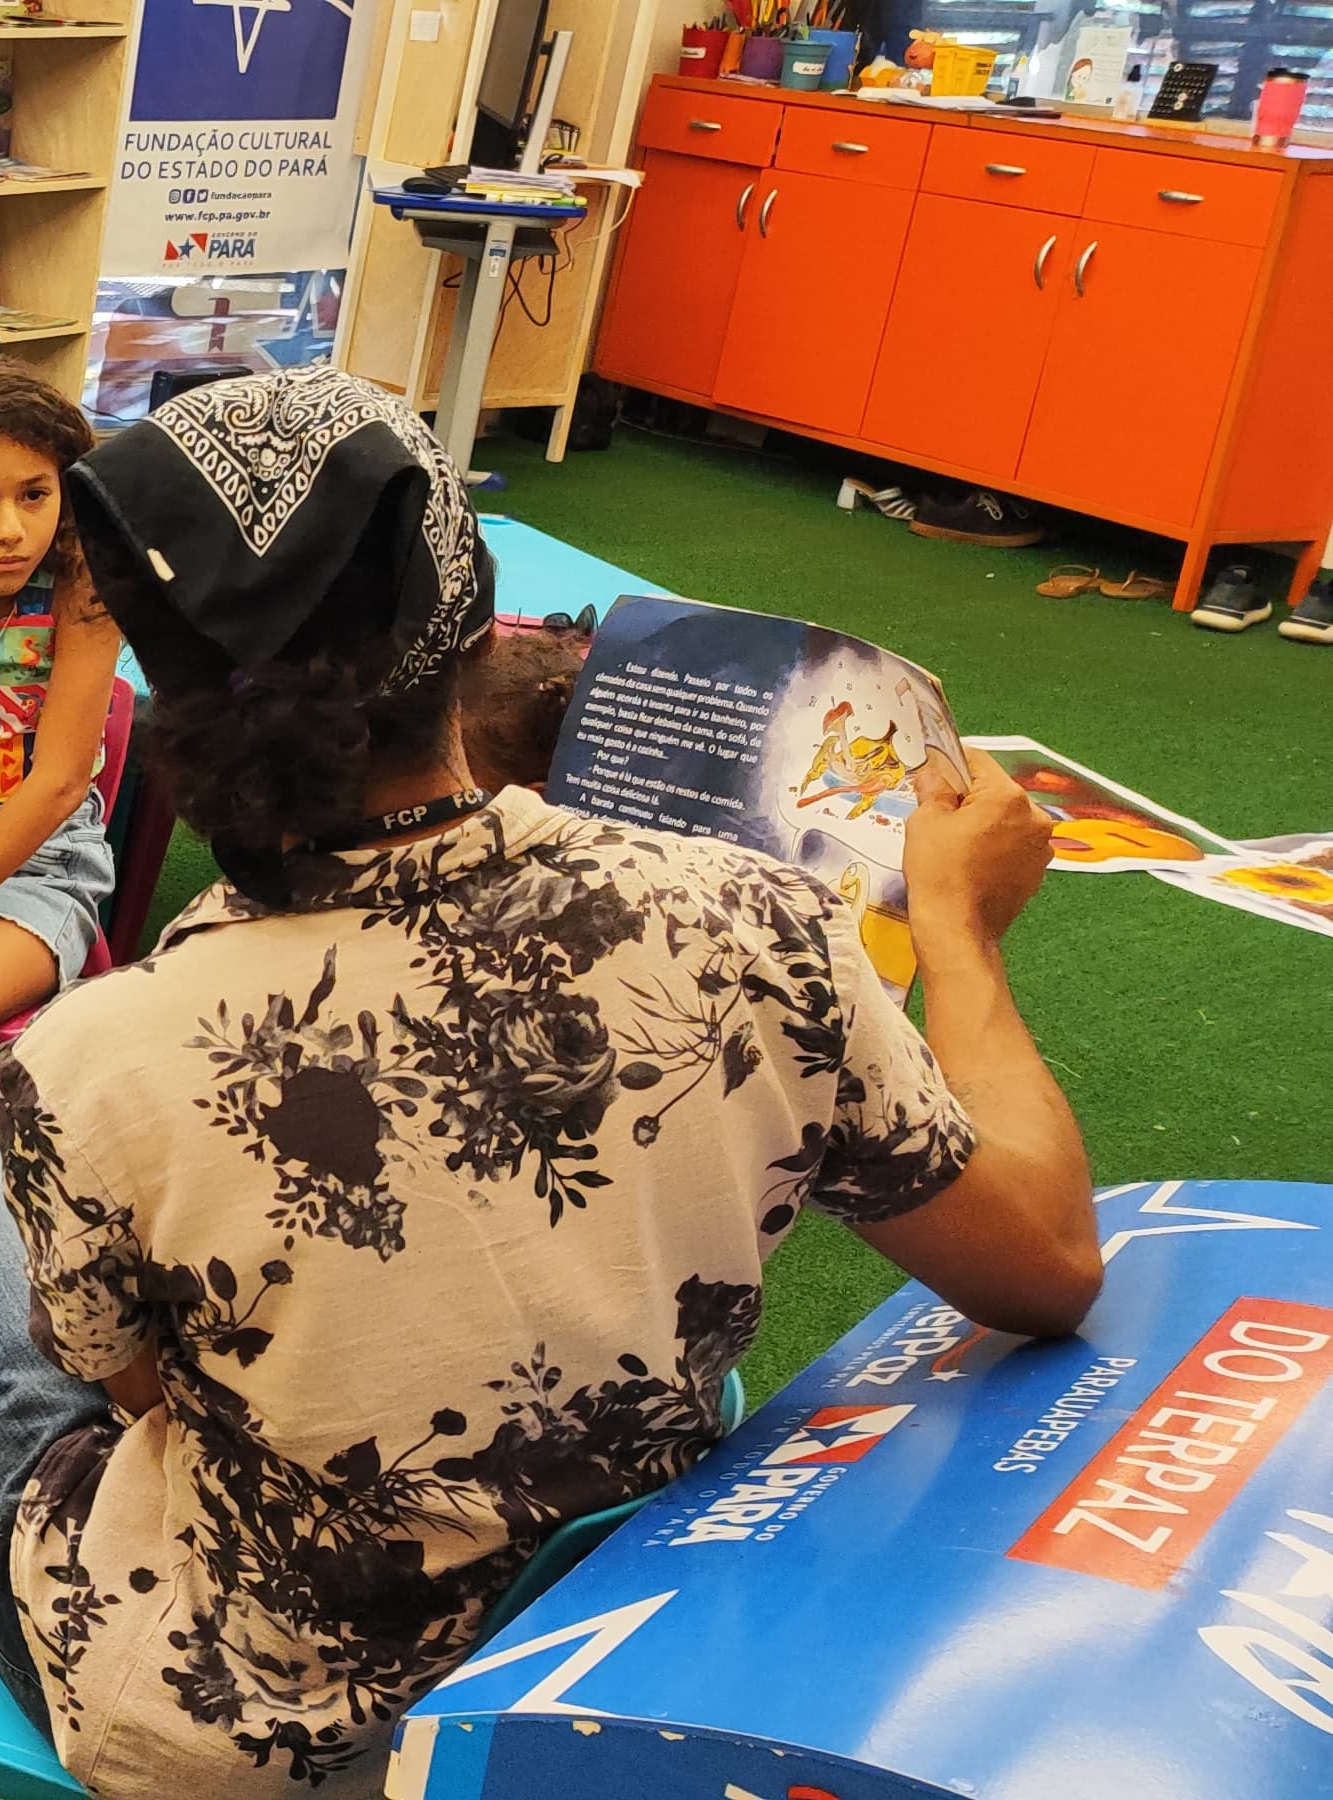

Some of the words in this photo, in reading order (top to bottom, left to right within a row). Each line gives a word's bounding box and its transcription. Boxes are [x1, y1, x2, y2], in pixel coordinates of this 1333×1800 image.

[124, 130, 234, 157] FUNDAÇÃO
[238, 131, 332, 150] CULTURAL
[121, 161, 152, 180] DO
[158, 159, 238, 179] ESTADO
[244, 159, 272, 178] DO
[278, 154, 328, 177] PARÁ
[165, 210, 271, 223] www.fcp.pa.gov.br
[715, 682, 731, 692] por
[734, 685, 757, 698] todos
[763, 691, 774, 701] os
[736, 700, 770, 716] Quando
[716, 729, 727, 740] do
[749, 736, 762, 748] de
[749, 722, 766, 732] por
[708, 743, 716, 754] O
[717, 745, 739, 760] lugar
[739, 753, 758, 764] que
[675, 787, 699, 800] restos
[699, 791, 711, 802] de
[711, 796, 746, 811] comida.
[383, 805, 428, 830] FCP
[579, 792, 587, 803] A
[691, 823, 712, 836] para
[717, 830, 739, 842] uma
[1202, 1320, 1331, 1383] DO
[992, 1356, 1138, 1474] PARAUAPEBAS
[1052, 1390, 1278, 1554] TERPAZ
[779, 1466, 847, 1520] GOVERNO
[754, 1525, 786, 1542] DO
